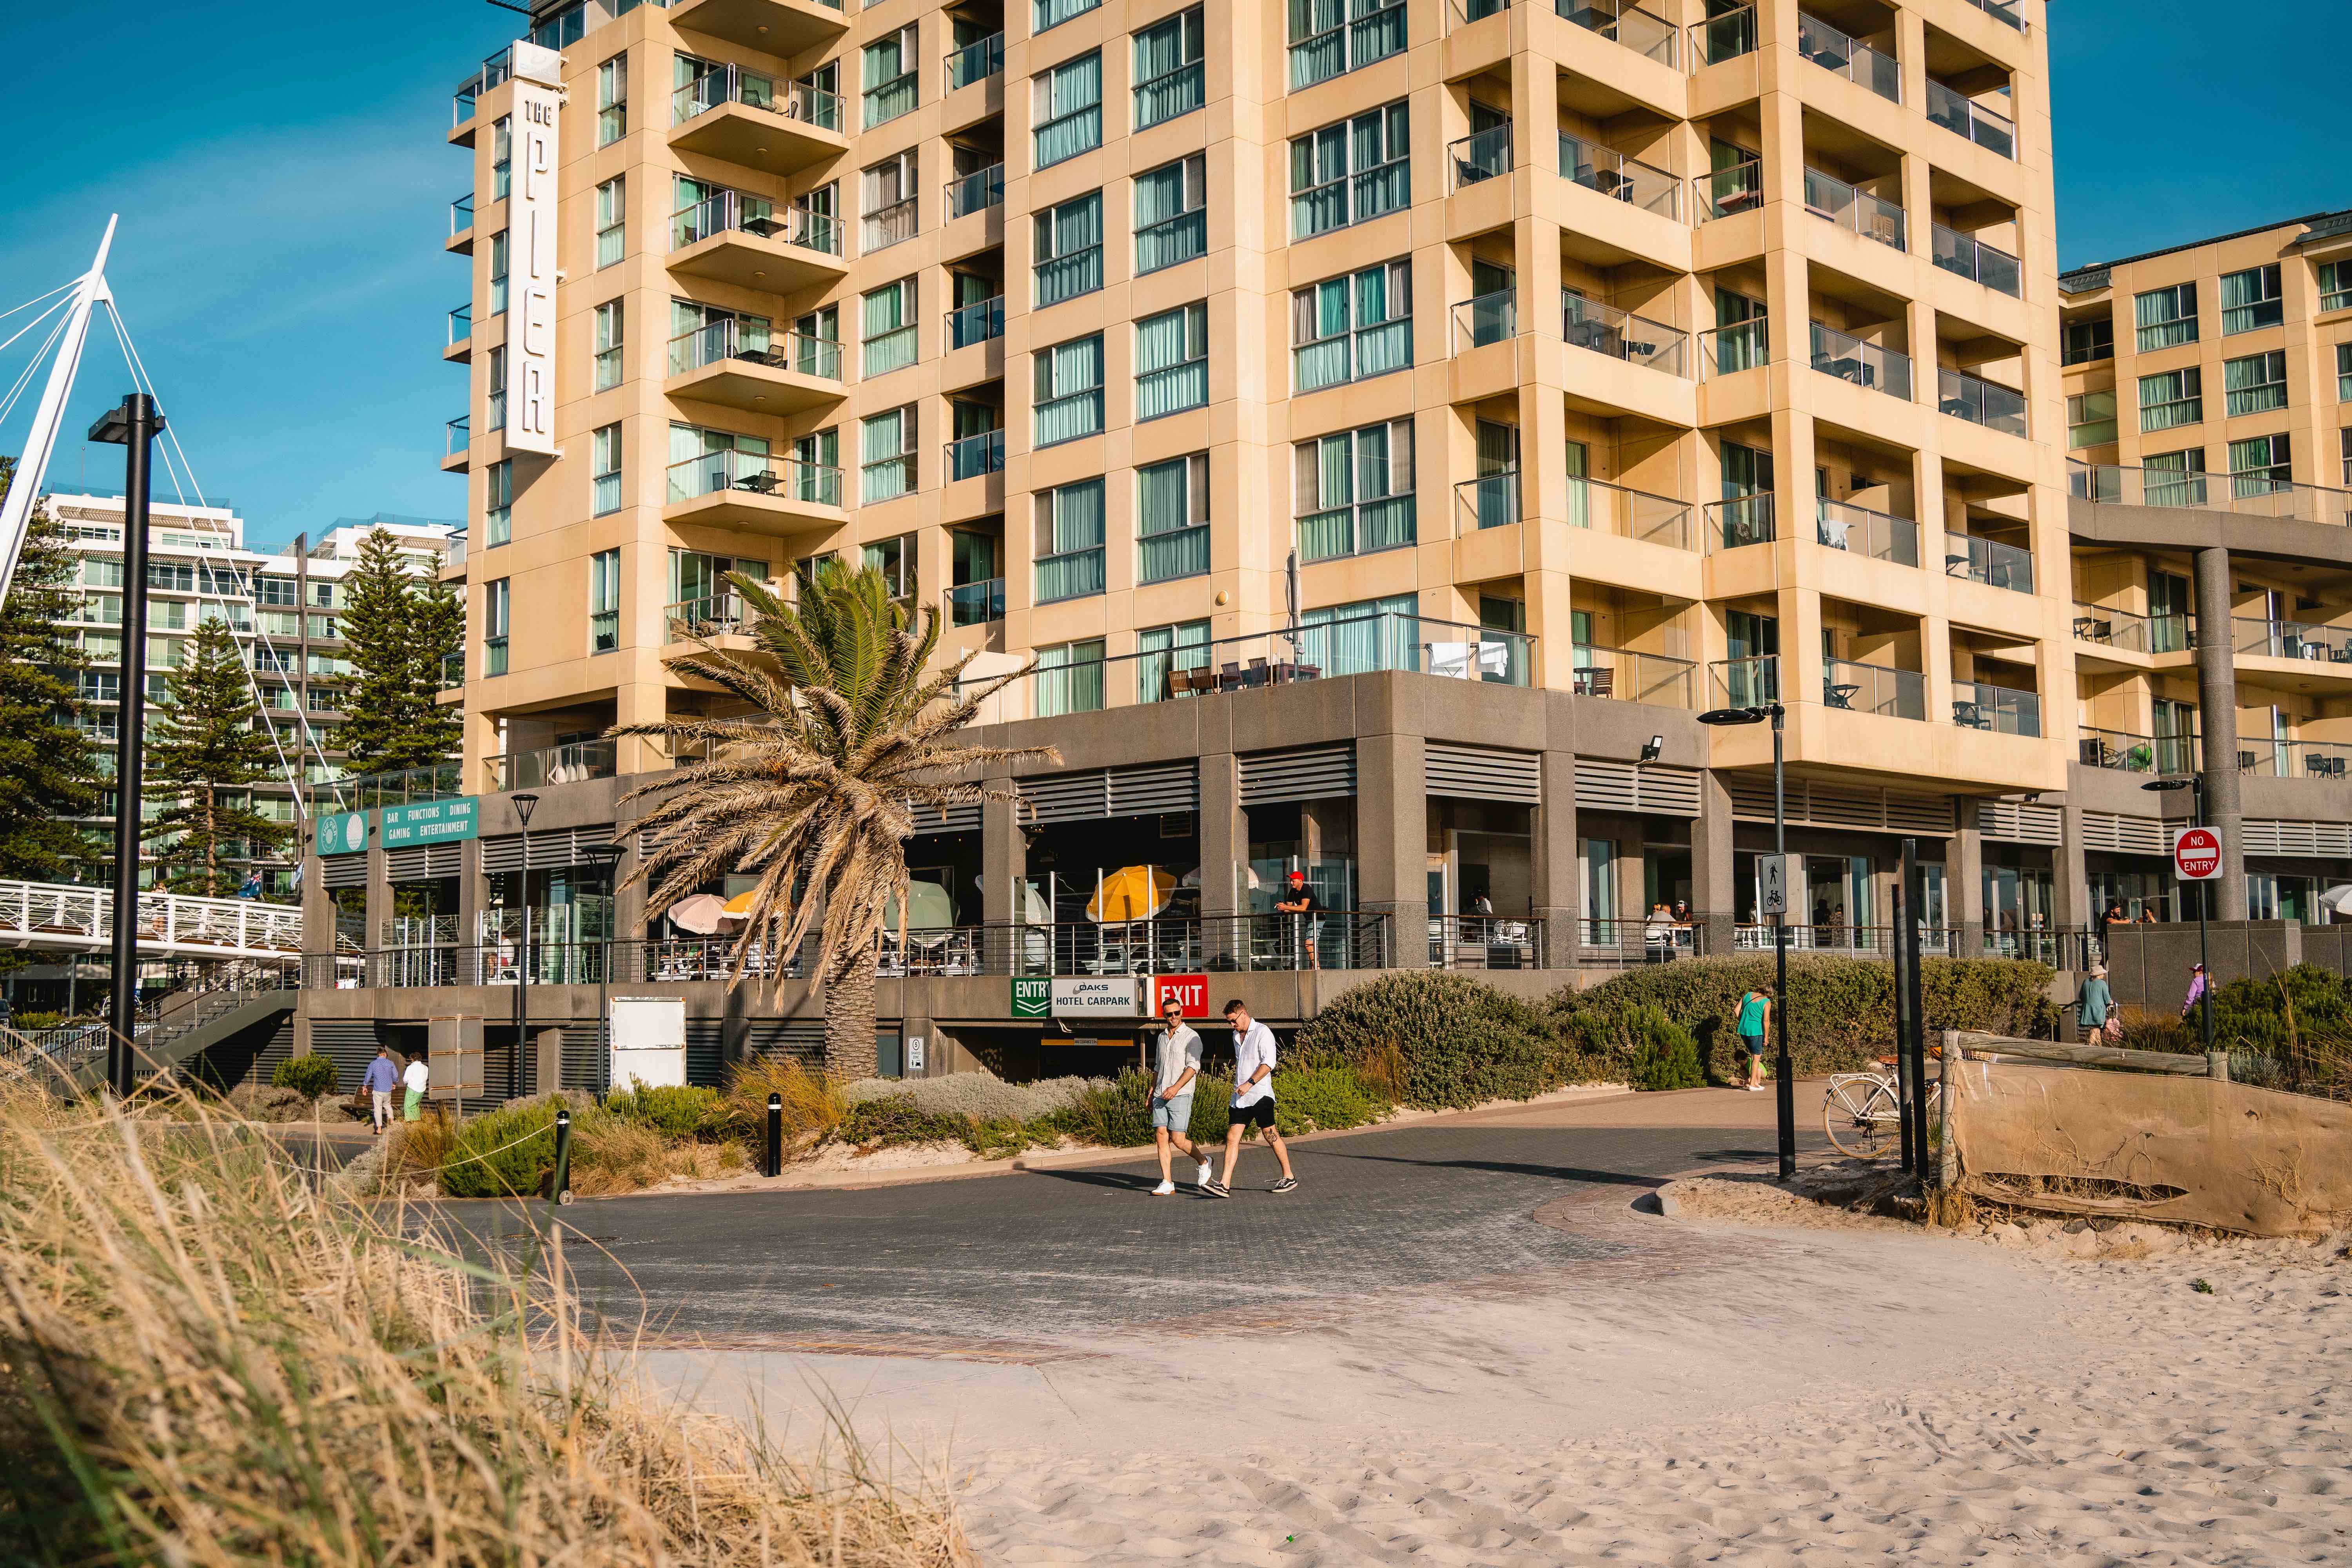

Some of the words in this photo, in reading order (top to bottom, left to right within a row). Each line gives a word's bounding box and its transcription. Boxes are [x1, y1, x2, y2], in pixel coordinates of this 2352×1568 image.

[524, 99, 552, 125] THE
[523, 131, 549, 433] PIER
[387, 812, 398, 823] BAR
[408, 807, 439, 821] FUNCTIONS
[450, 803, 470, 815] DINING
[389, 828, 410, 840] GAMING
[420, 820, 468, 836] ENTERTAINMENT
[2190, 836, 2204, 846] NO
[2184, 860, 2215, 871] ENTRY
[1056, 997, 1084, 1005] HOTEL
[1087, 997, 1130, 1005] CARPARK
[1161, 985, 1202, 1006] EXIT
